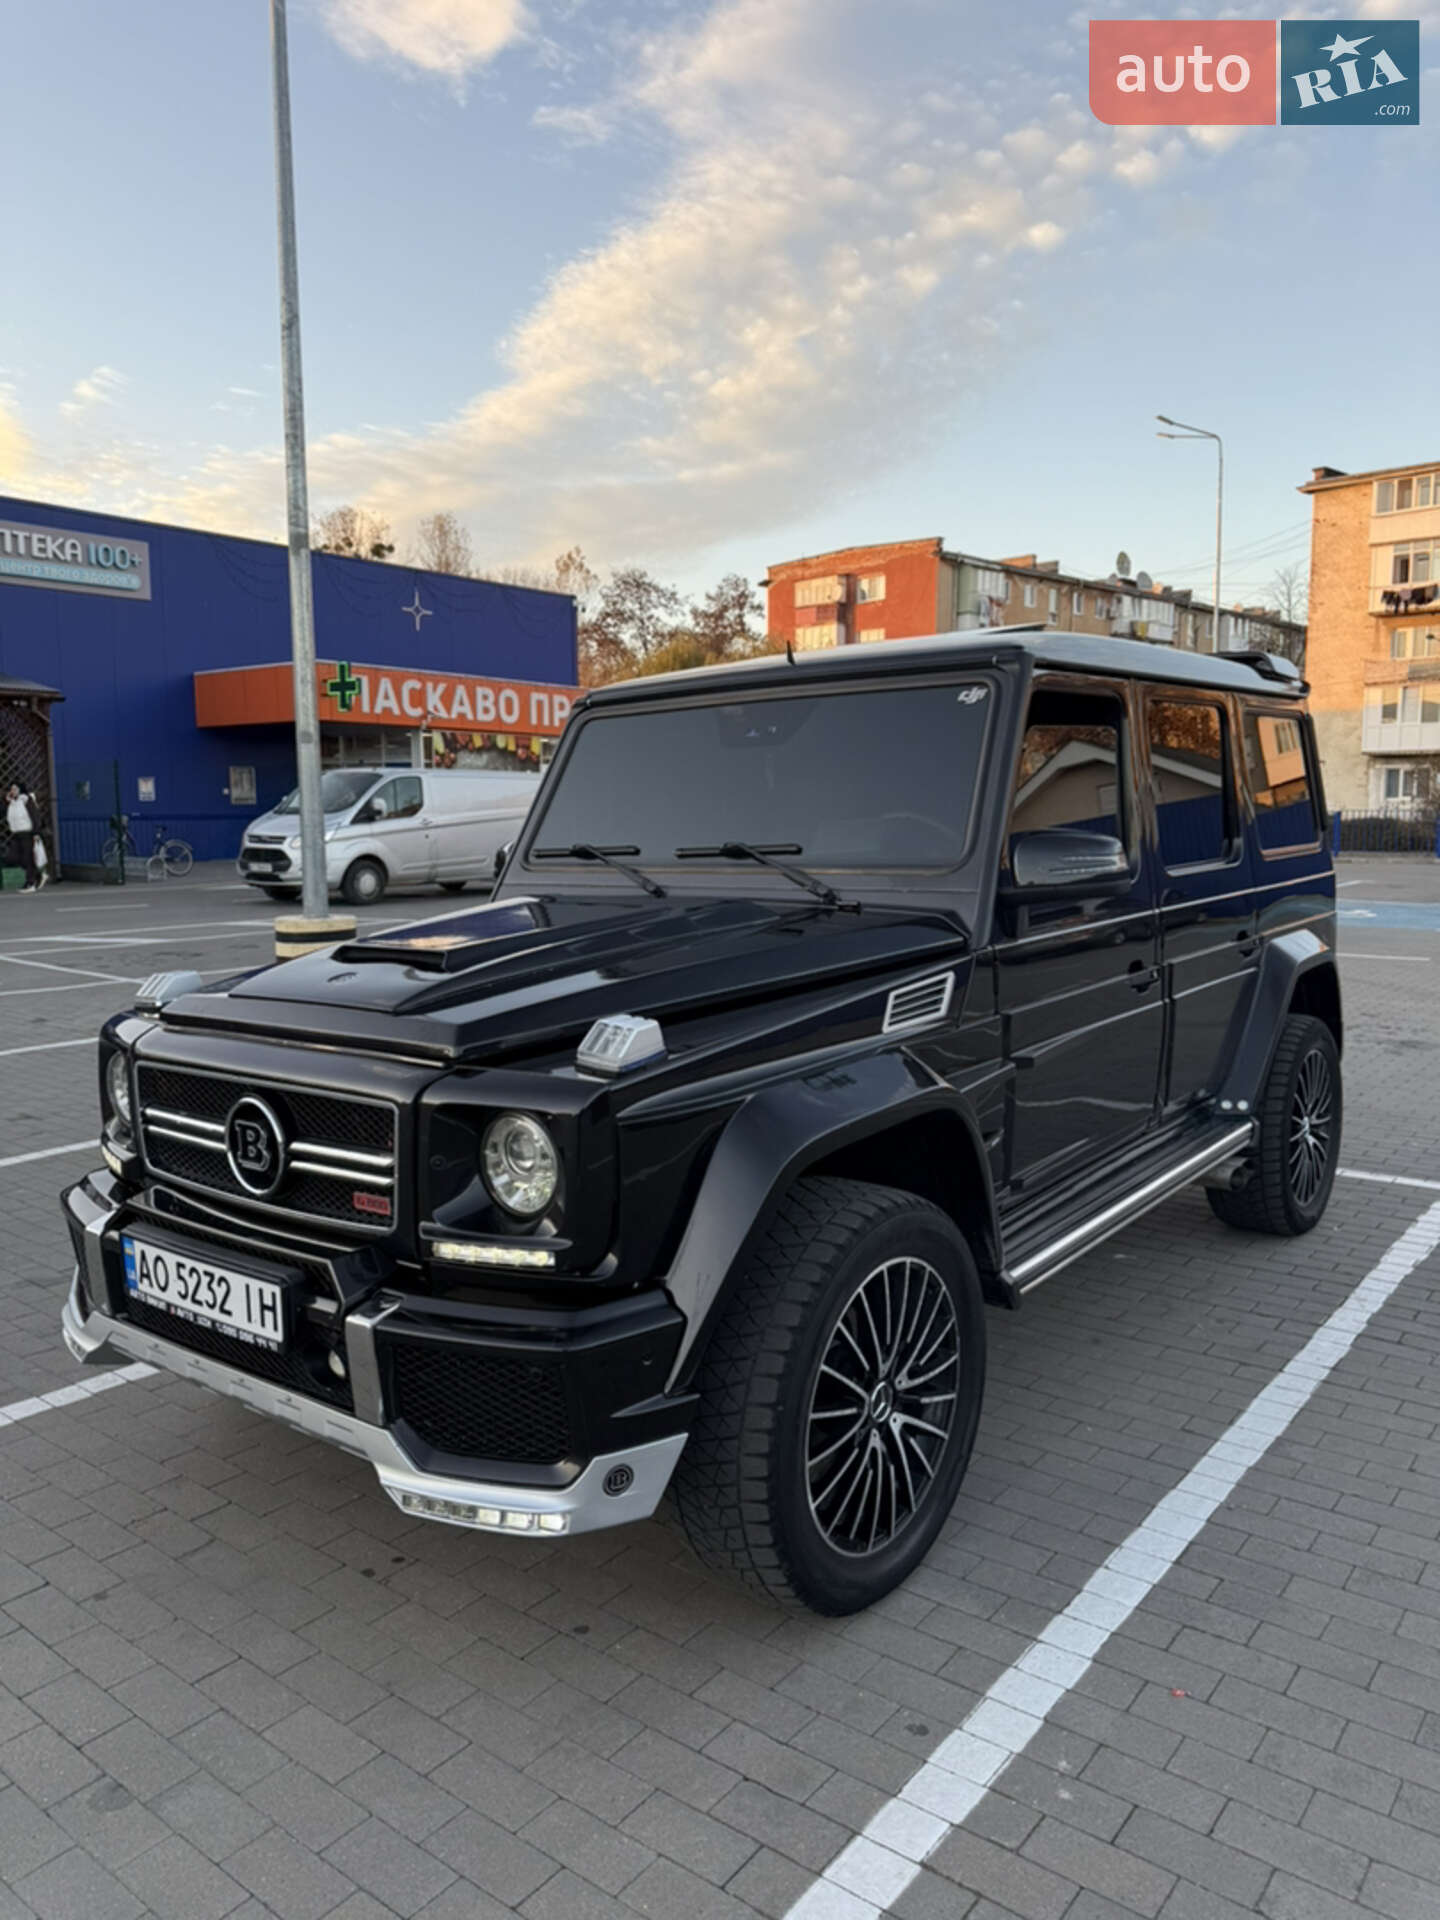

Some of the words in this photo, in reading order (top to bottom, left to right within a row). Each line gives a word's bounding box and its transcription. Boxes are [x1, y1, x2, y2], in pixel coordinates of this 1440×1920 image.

[88, 541, 143, 570] 100+
[529, 691, 577, 728] ПР
[234, 1119, 271, 1172] B
[138, 1249, 170, 1293] AO
[175, 1261, 233, 1318] 5232
[244, 1282, 280, 1334] IH
